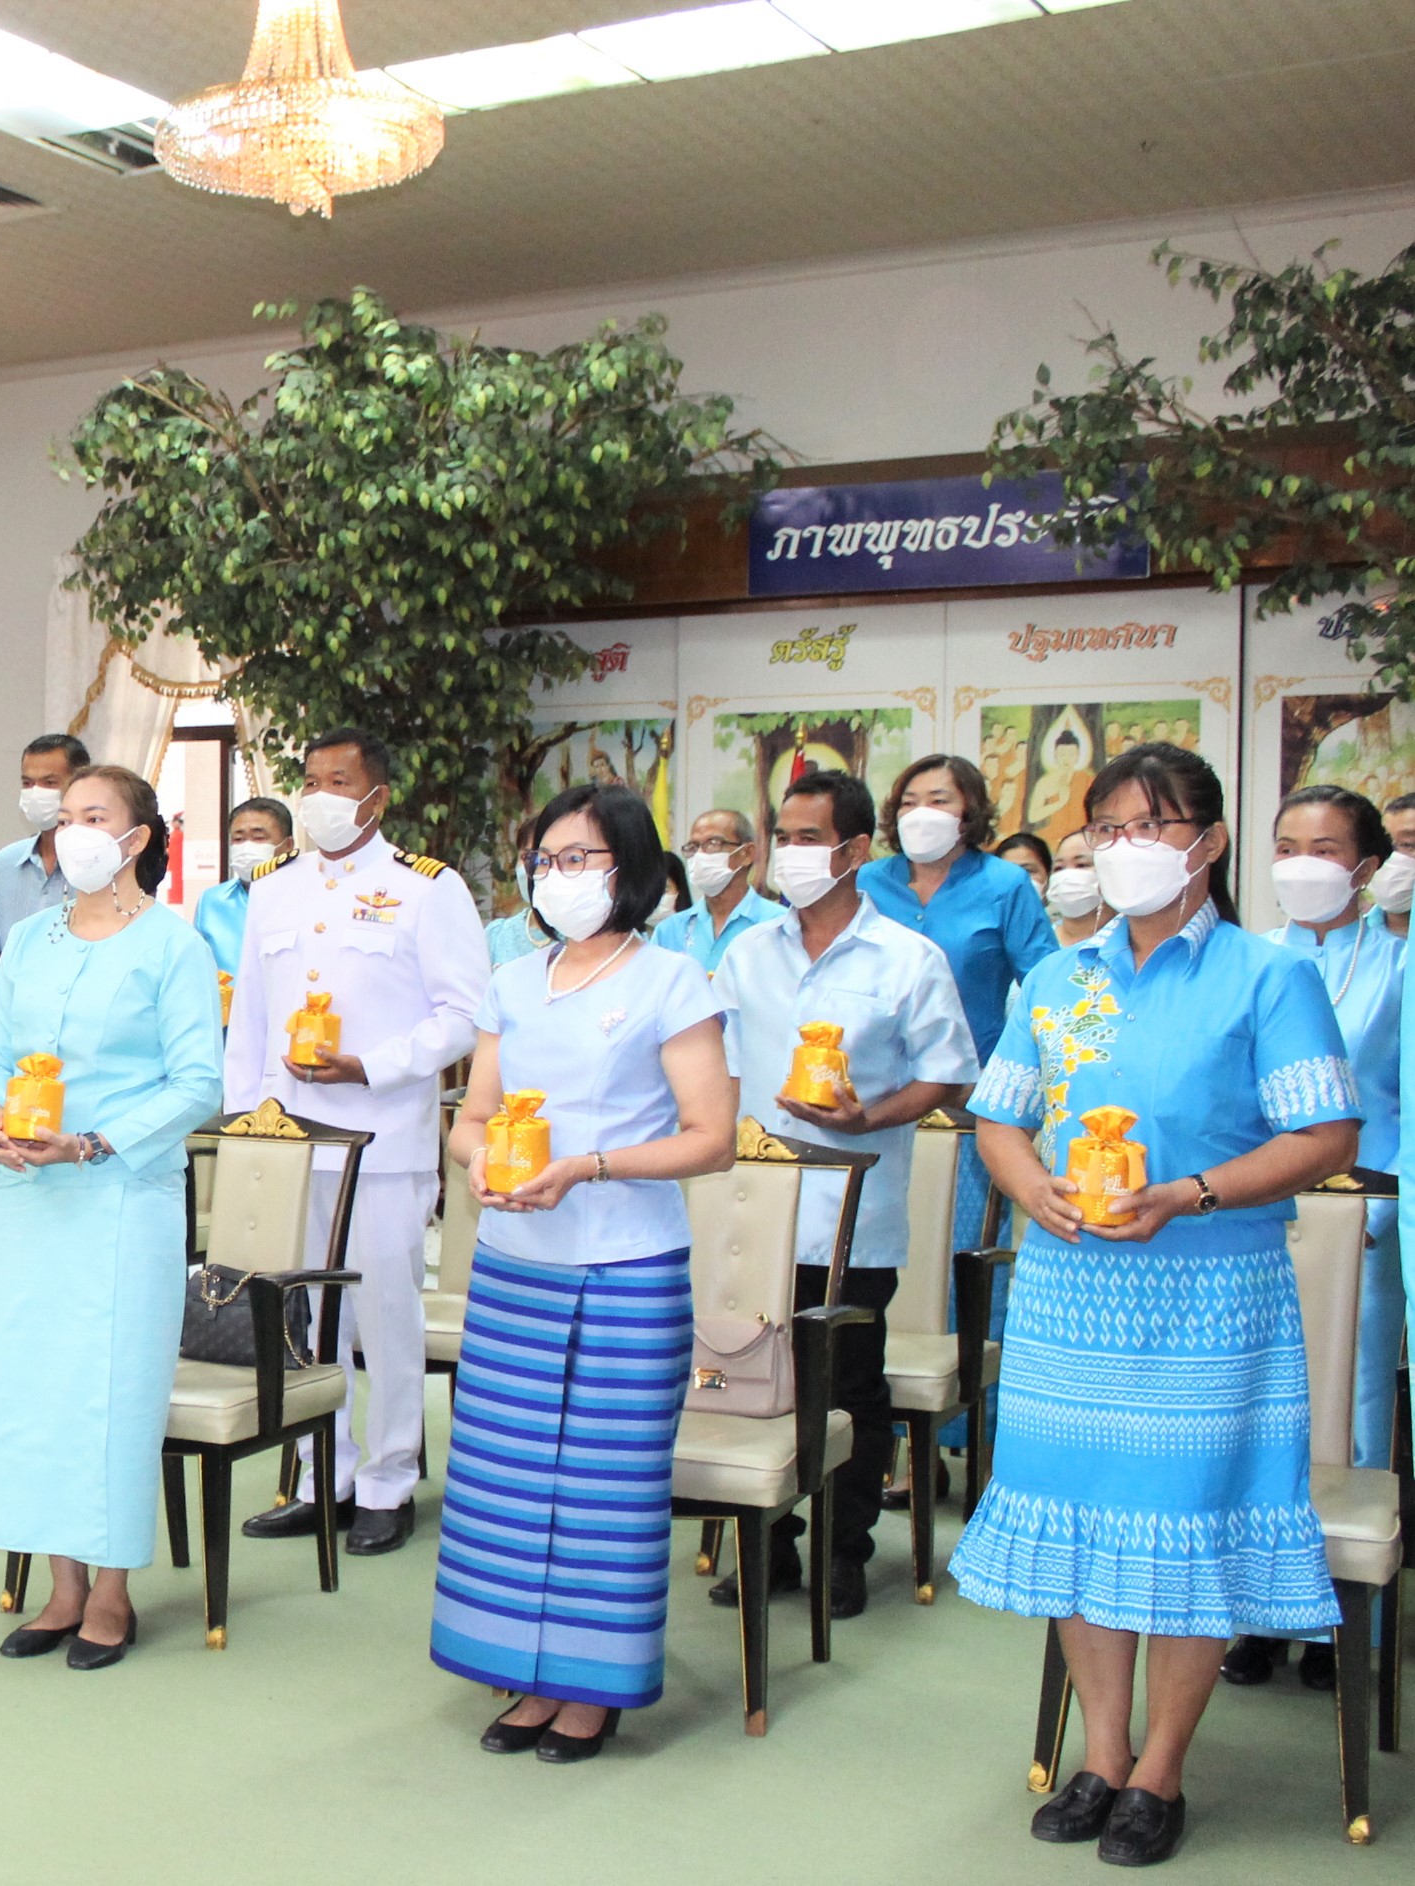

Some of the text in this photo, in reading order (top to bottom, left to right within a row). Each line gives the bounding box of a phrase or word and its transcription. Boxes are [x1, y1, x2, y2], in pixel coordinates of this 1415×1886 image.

[769, 624, 858, 671] ตรัสรู้
[1007, 621, 1180, 663] ปฐมเทศนา
